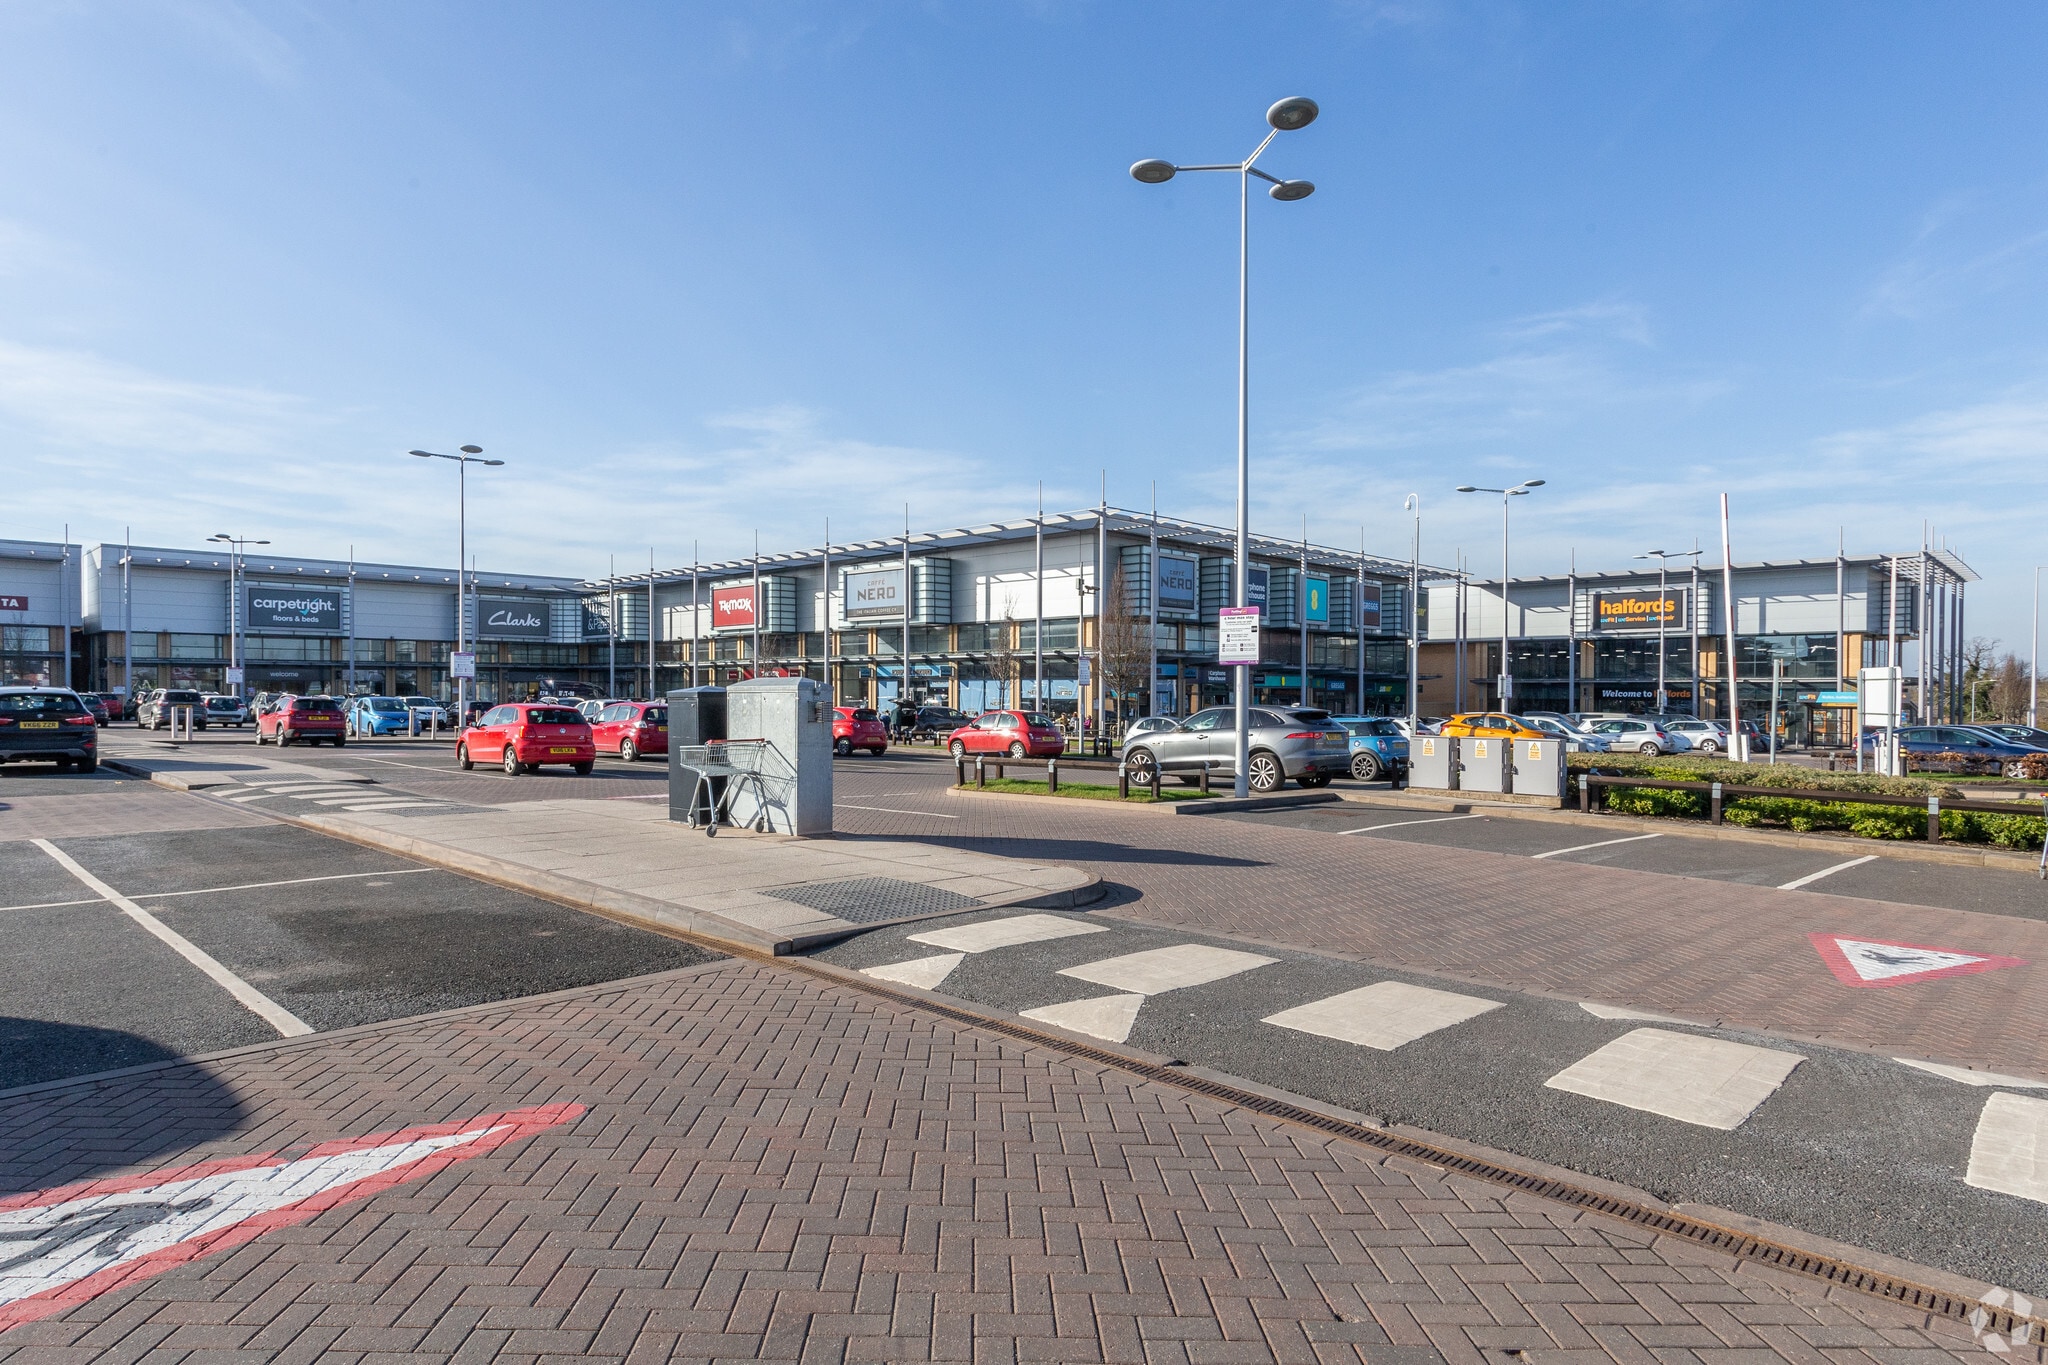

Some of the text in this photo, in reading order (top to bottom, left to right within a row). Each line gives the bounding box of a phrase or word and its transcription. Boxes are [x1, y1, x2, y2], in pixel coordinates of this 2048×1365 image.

[1160, 576, 1193, 591] NERO
[857, 586, 896, 602] NERO
[1600, 597, 1676, 615] halfords
[488, 610, 541, 627] Clarks
[1602, 689, 1641, 698] Welcome
[1643, 690, 1653, 698] to
